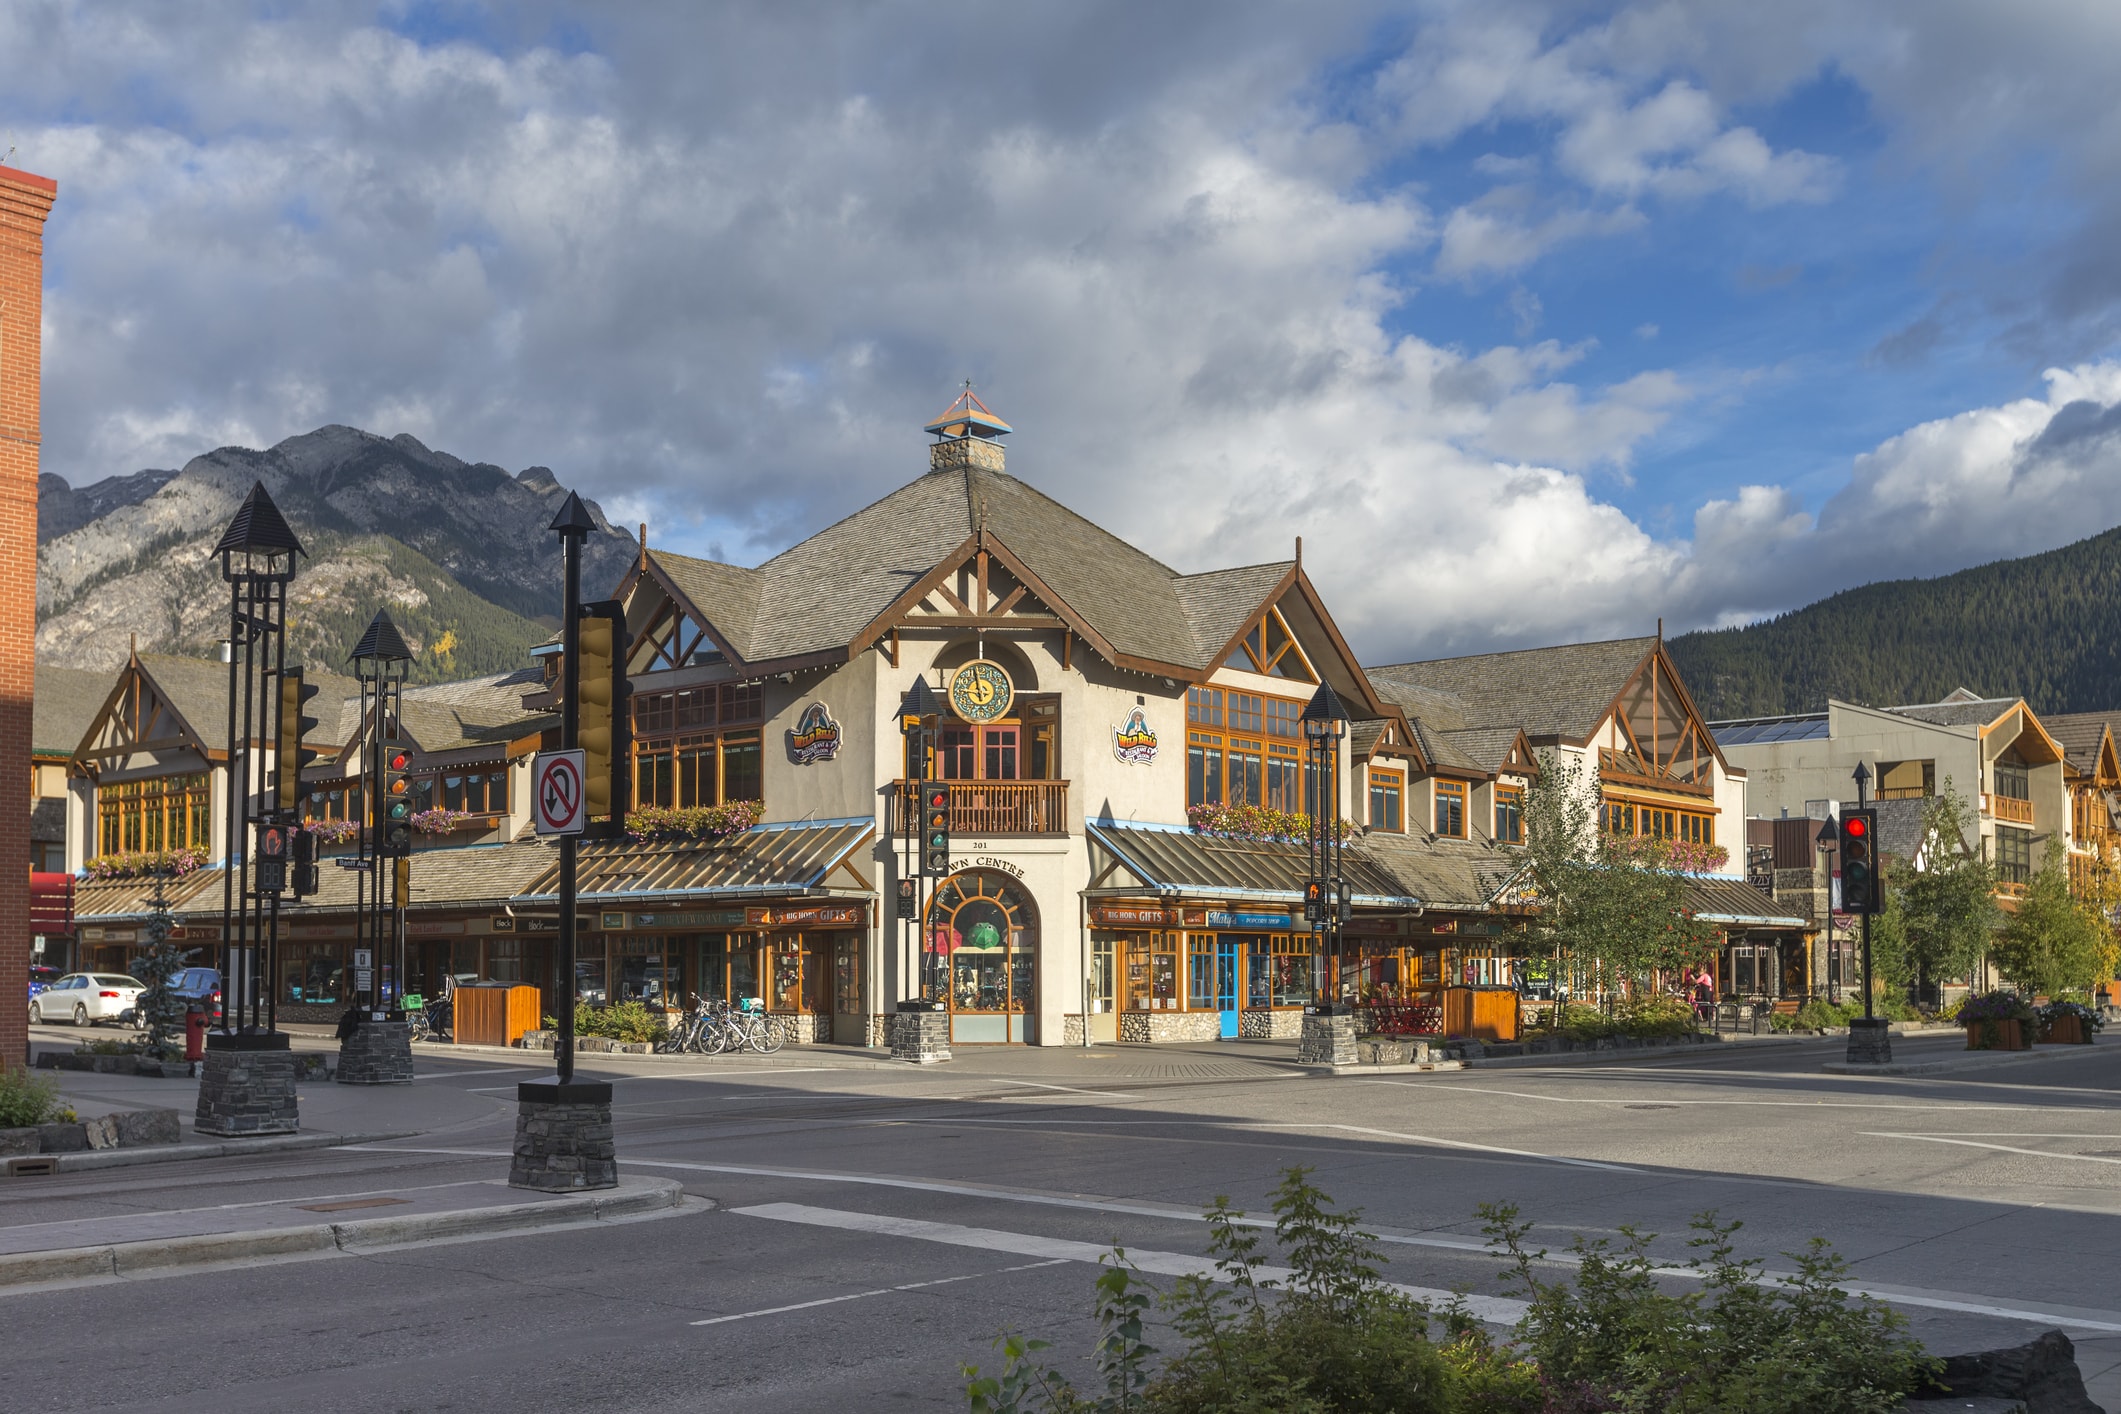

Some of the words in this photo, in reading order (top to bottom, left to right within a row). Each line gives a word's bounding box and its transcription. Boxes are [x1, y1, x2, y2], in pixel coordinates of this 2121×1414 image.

[959, 677, 968, 685] 10
[793, 733, 815, 749] WILD
[1117, 734, 1138, 748] WILD
[949, 858, 969, 871] WN
[976, 857, 1025, 879] CENTRE
[786, 912, 797, 920] BIG
[798, 912, 817, 920] HORN
[820, 909, 846, 920] GIFTS
[1108, 911, 1119, 919] BIG
[1119, 911, 1137, 920] HORN
[1139, 911, 1162, 922] GIFTS
